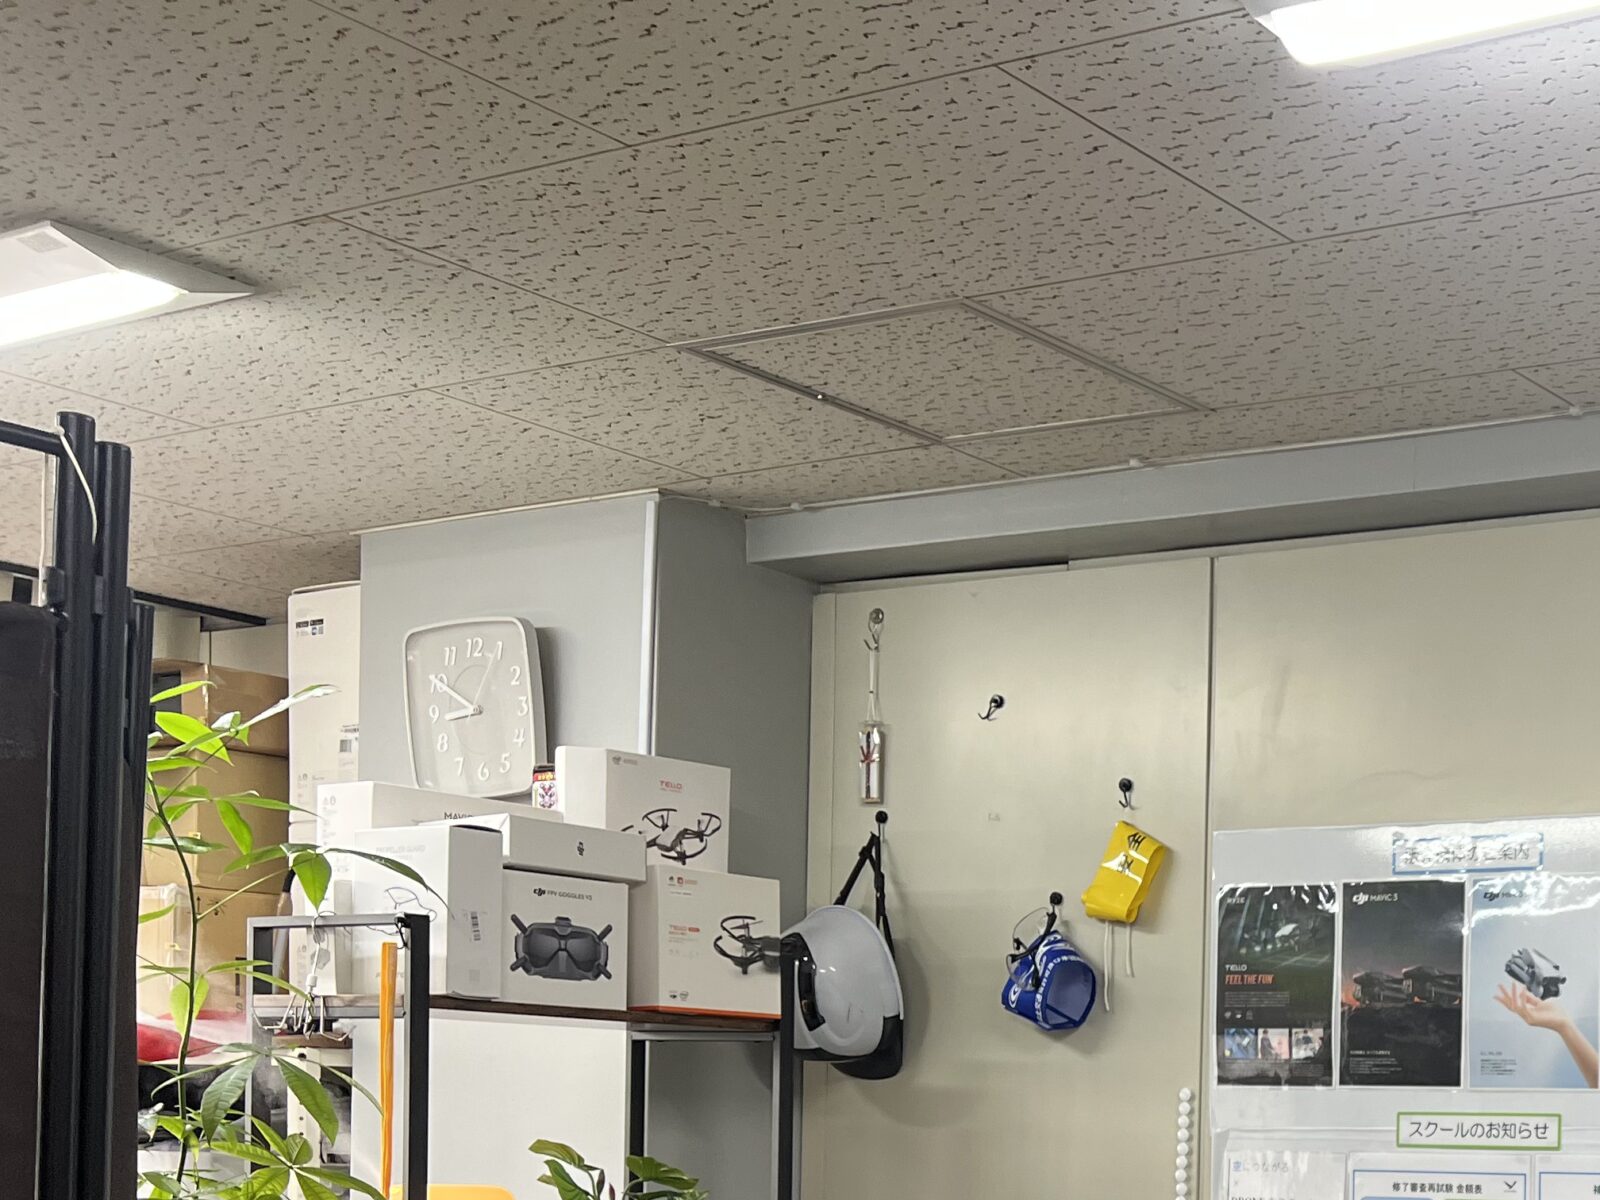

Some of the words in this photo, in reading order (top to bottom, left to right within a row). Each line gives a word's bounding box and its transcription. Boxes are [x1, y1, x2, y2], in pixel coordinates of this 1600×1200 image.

[444, 646, 457, 666] 11
[466, 637, 483, 658] 12
[496, 641, 503, 660] 1
[510, 665, 521, 685] 2
[429, 705, 440, 724] 9
[518, 696, 528, 716] 3
[437, 733, 448, 752] 8
[513, 728, 525, 747] 4
[454, 757, 464, 776] 7
[478, 762, 489, 781] 6
[499, 752, 511, 773] 5
[1225, 975, 1242, 985] FEEL
[1243, 975, 1257, 985] THE
[1258, 974, 1273, 984] FUN
[1409, 1121, 1549, 1139] スクールのお知らせ
[1393, 1181, 1453, 1194] 修了審査再試験
[1456, 1184, 1483, 1194] 金額表
